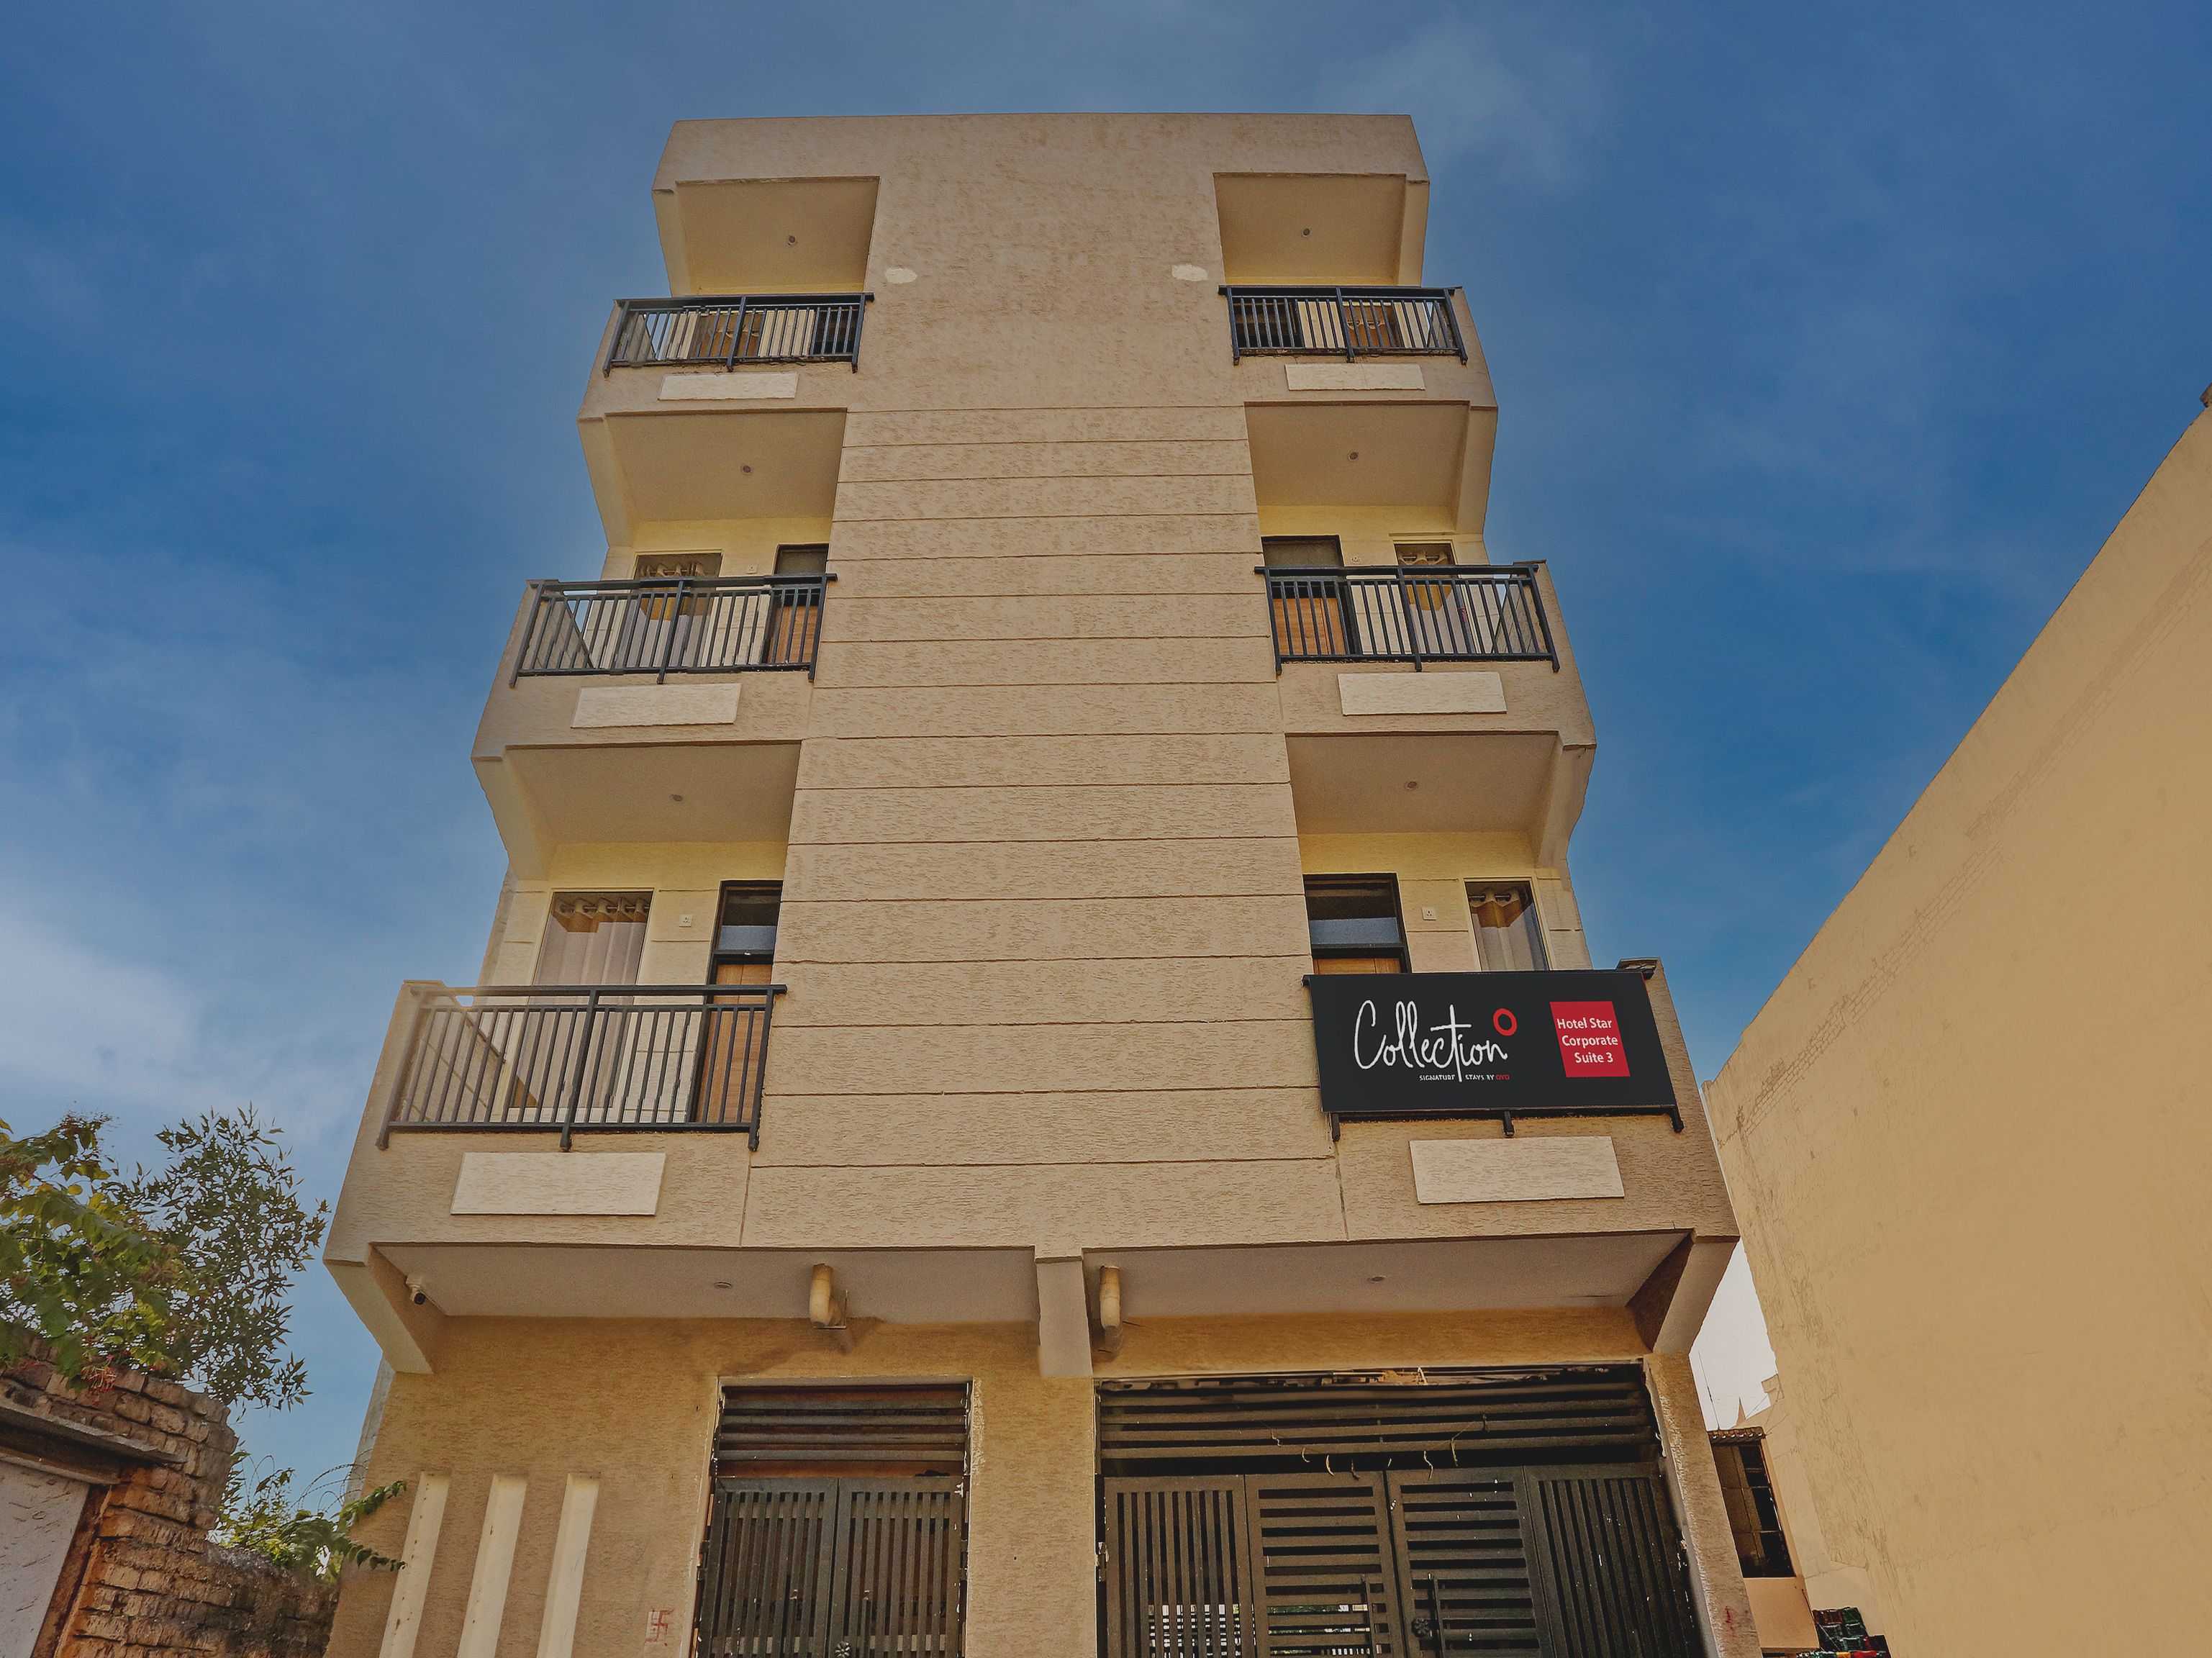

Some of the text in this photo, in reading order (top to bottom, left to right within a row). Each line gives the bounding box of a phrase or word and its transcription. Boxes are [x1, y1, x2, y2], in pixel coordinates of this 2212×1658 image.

[1556, 1018, 1612, 1029] Hotel Star
[1354, 1000, 1508, 1082] Collection
[1561, 1035, 1618, 1048] Corporate
[1574, 1051, 1613, 1063] Suite 3
